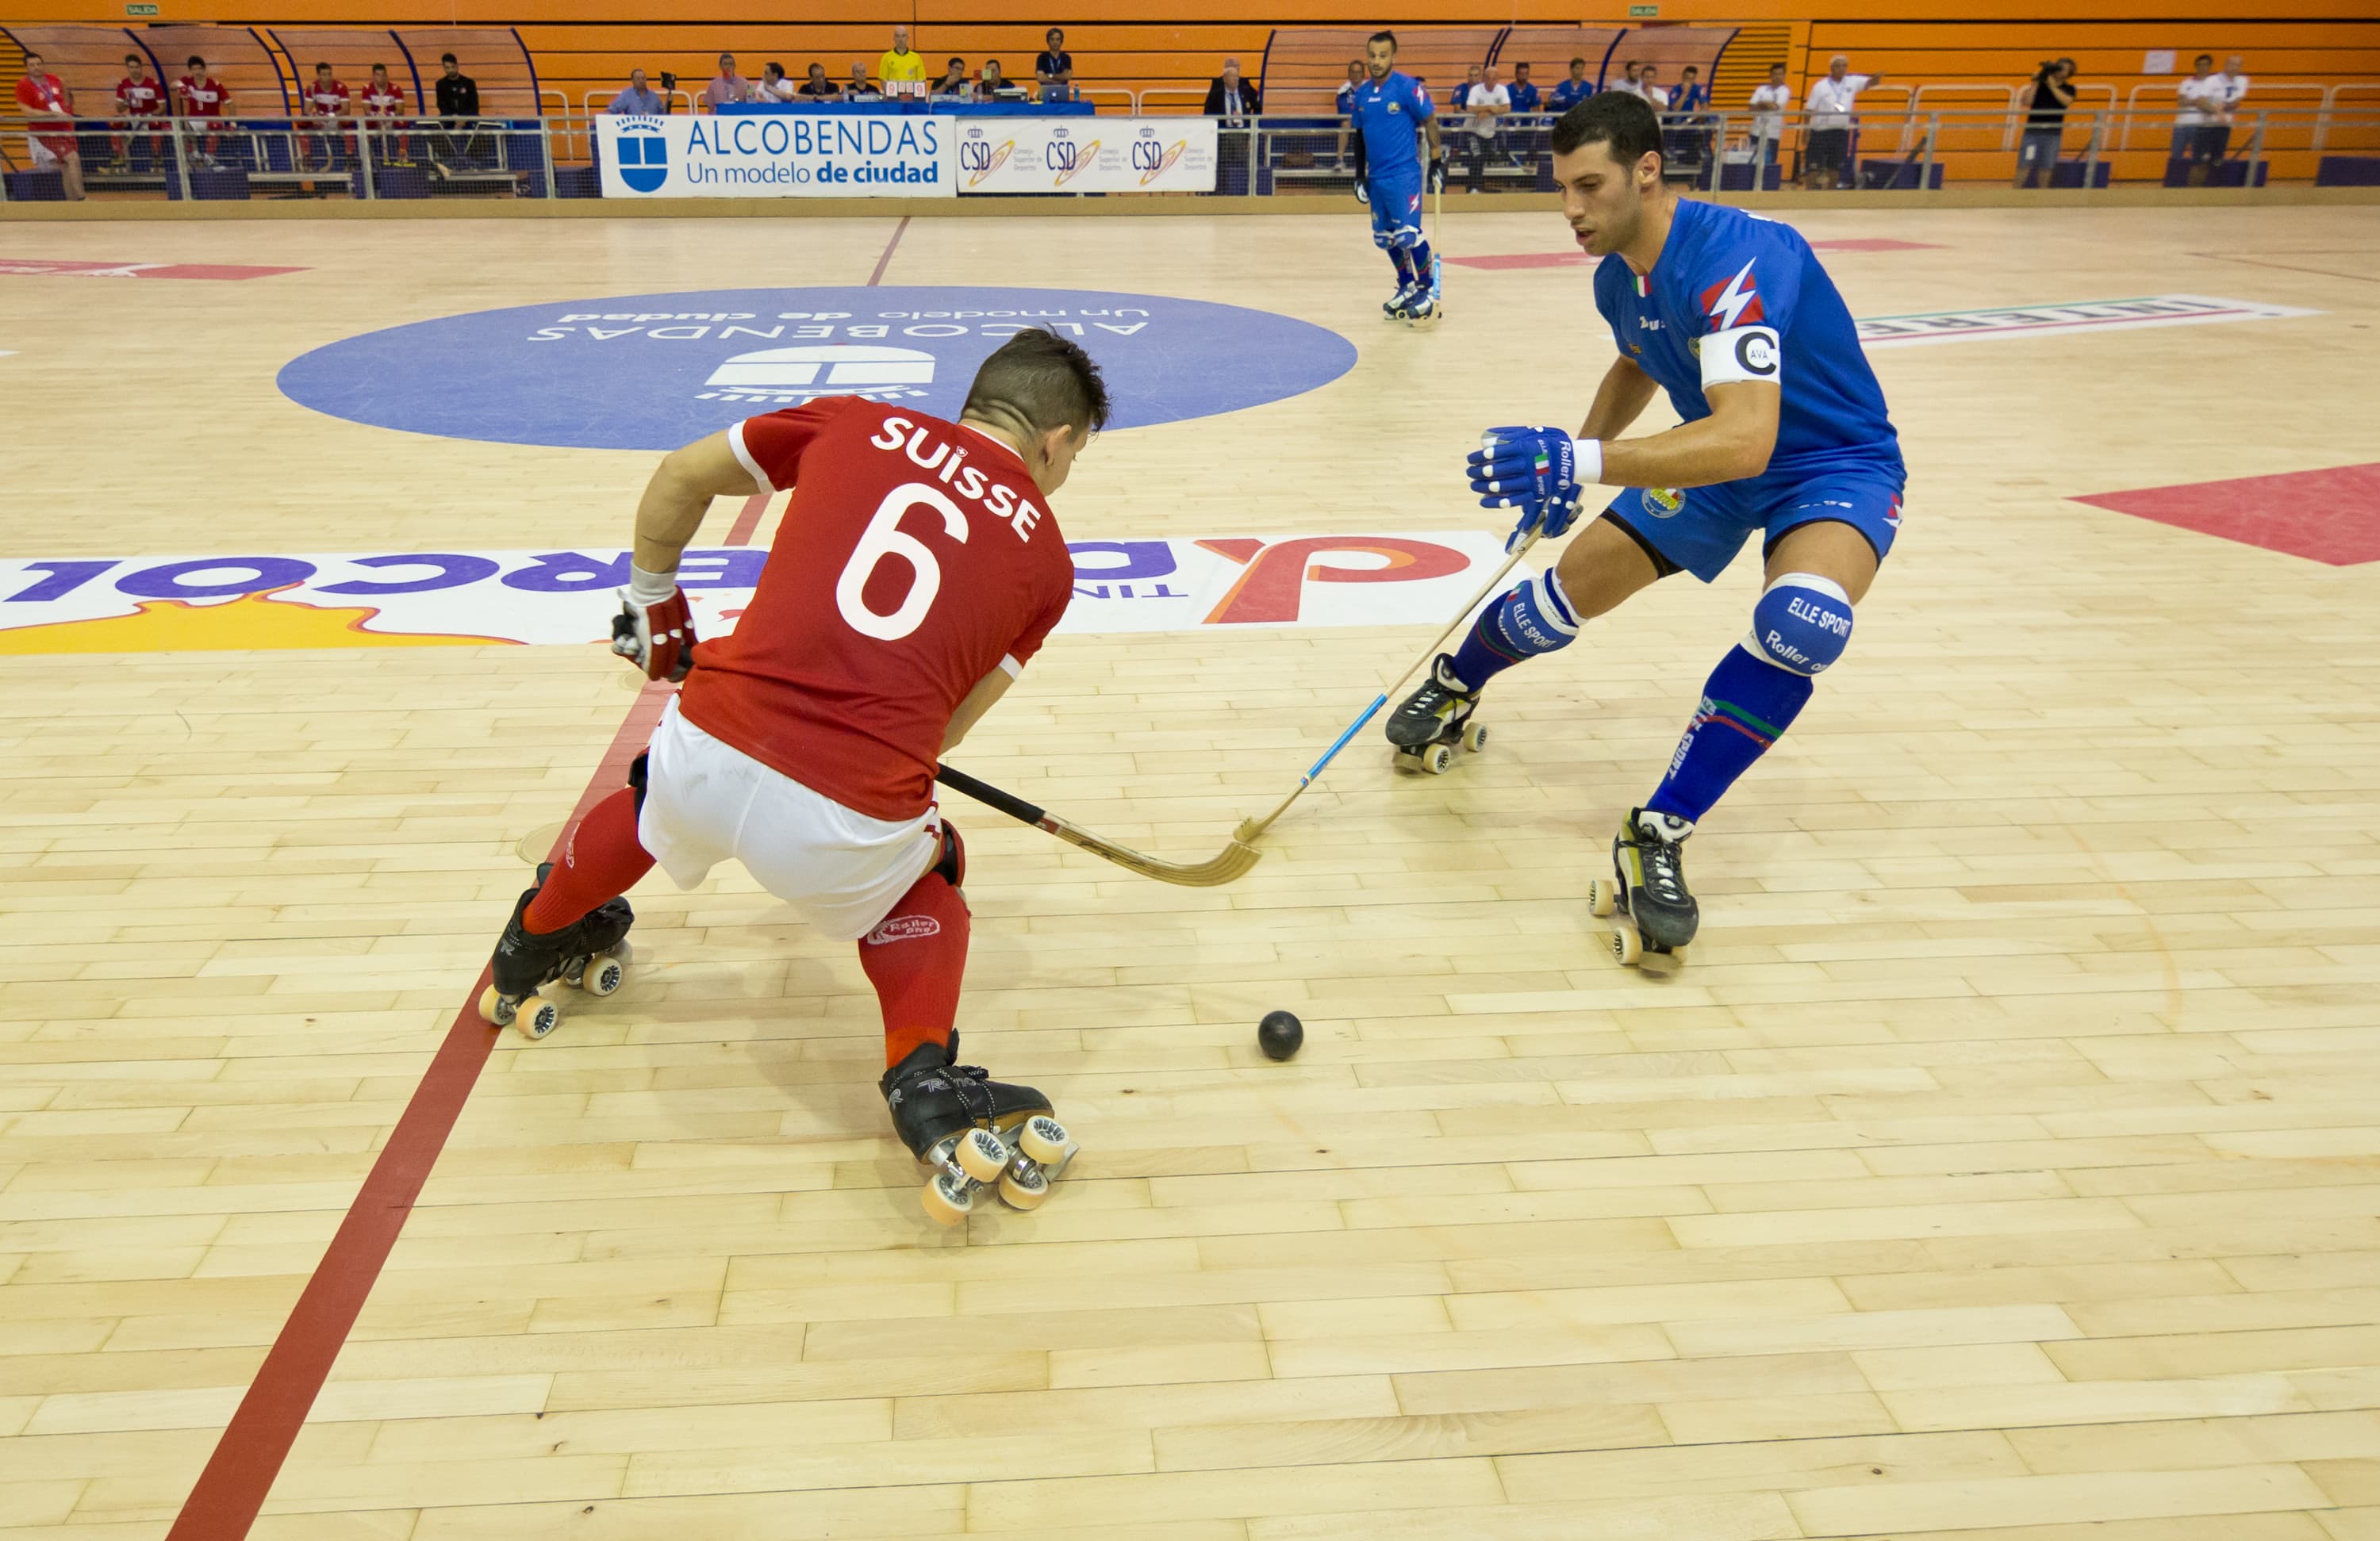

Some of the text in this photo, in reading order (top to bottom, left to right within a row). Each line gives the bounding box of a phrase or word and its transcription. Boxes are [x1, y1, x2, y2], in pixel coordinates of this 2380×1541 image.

[687, 121, 938, 155] ALCOBENDAS
[686, 161, 938, 183] Un modelo de ciudad
[960, 141, 991, 171] CSD
[1046, 141, 1077, 171] CSD
[1132, 141, 1162, 171] CSD
[555, 309, 1149, 323] Un modelo de ciudad
[1560, 440, 1572, 479] Roller
[835, 482, 969, 641] 6
[1513, 602, 1557, 648] ELLE SPORT
[1787, 597, 1852, 638] ELLE SPORT
[1765, 630, 1810, 665] Roller
